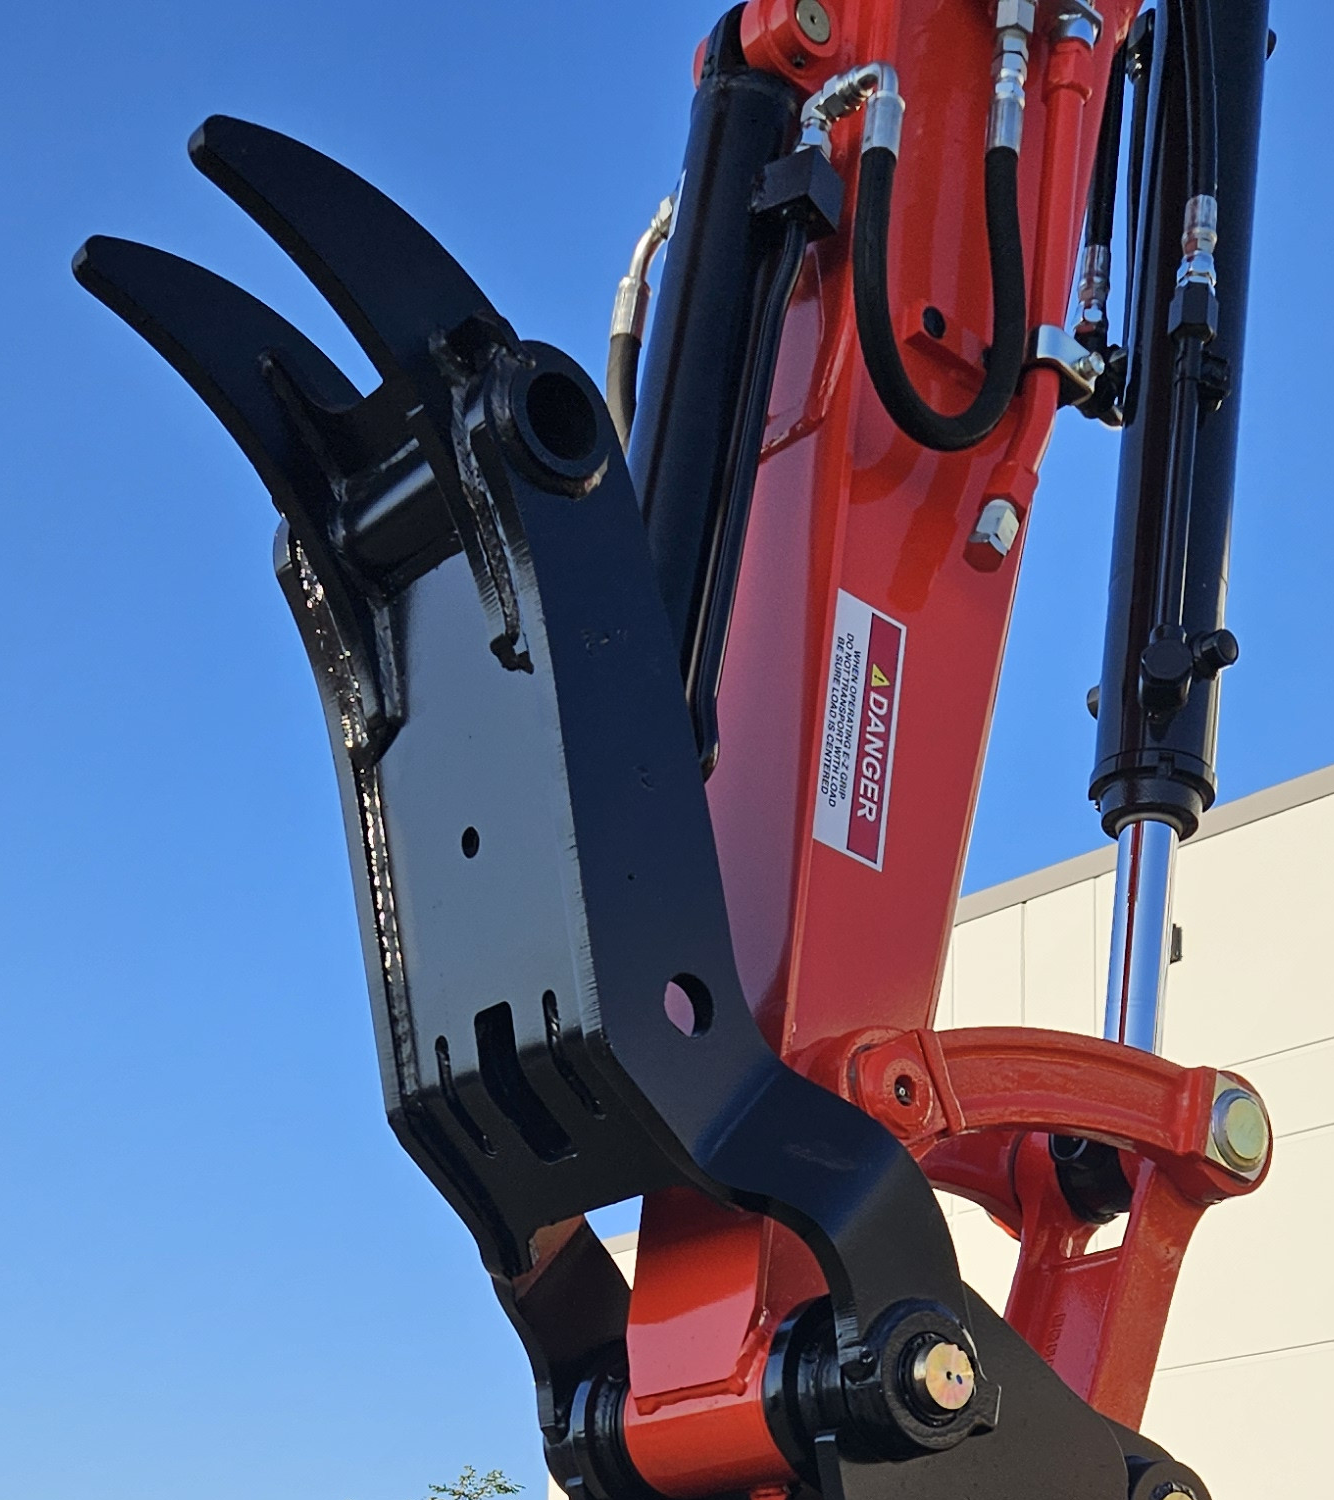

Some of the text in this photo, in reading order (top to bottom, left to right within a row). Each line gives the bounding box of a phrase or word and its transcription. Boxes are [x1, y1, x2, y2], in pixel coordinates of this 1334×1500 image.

[820, 636, 844, 794] BE SURE LOAD IS CENTERED
[828, 633, 854, 808] DO NOT TRANSPORT WITH LOAD
[839, 651, 861, 800] WHEN OPERATING E-Z GRIP
[856, 691, 889, 823] DANGER
